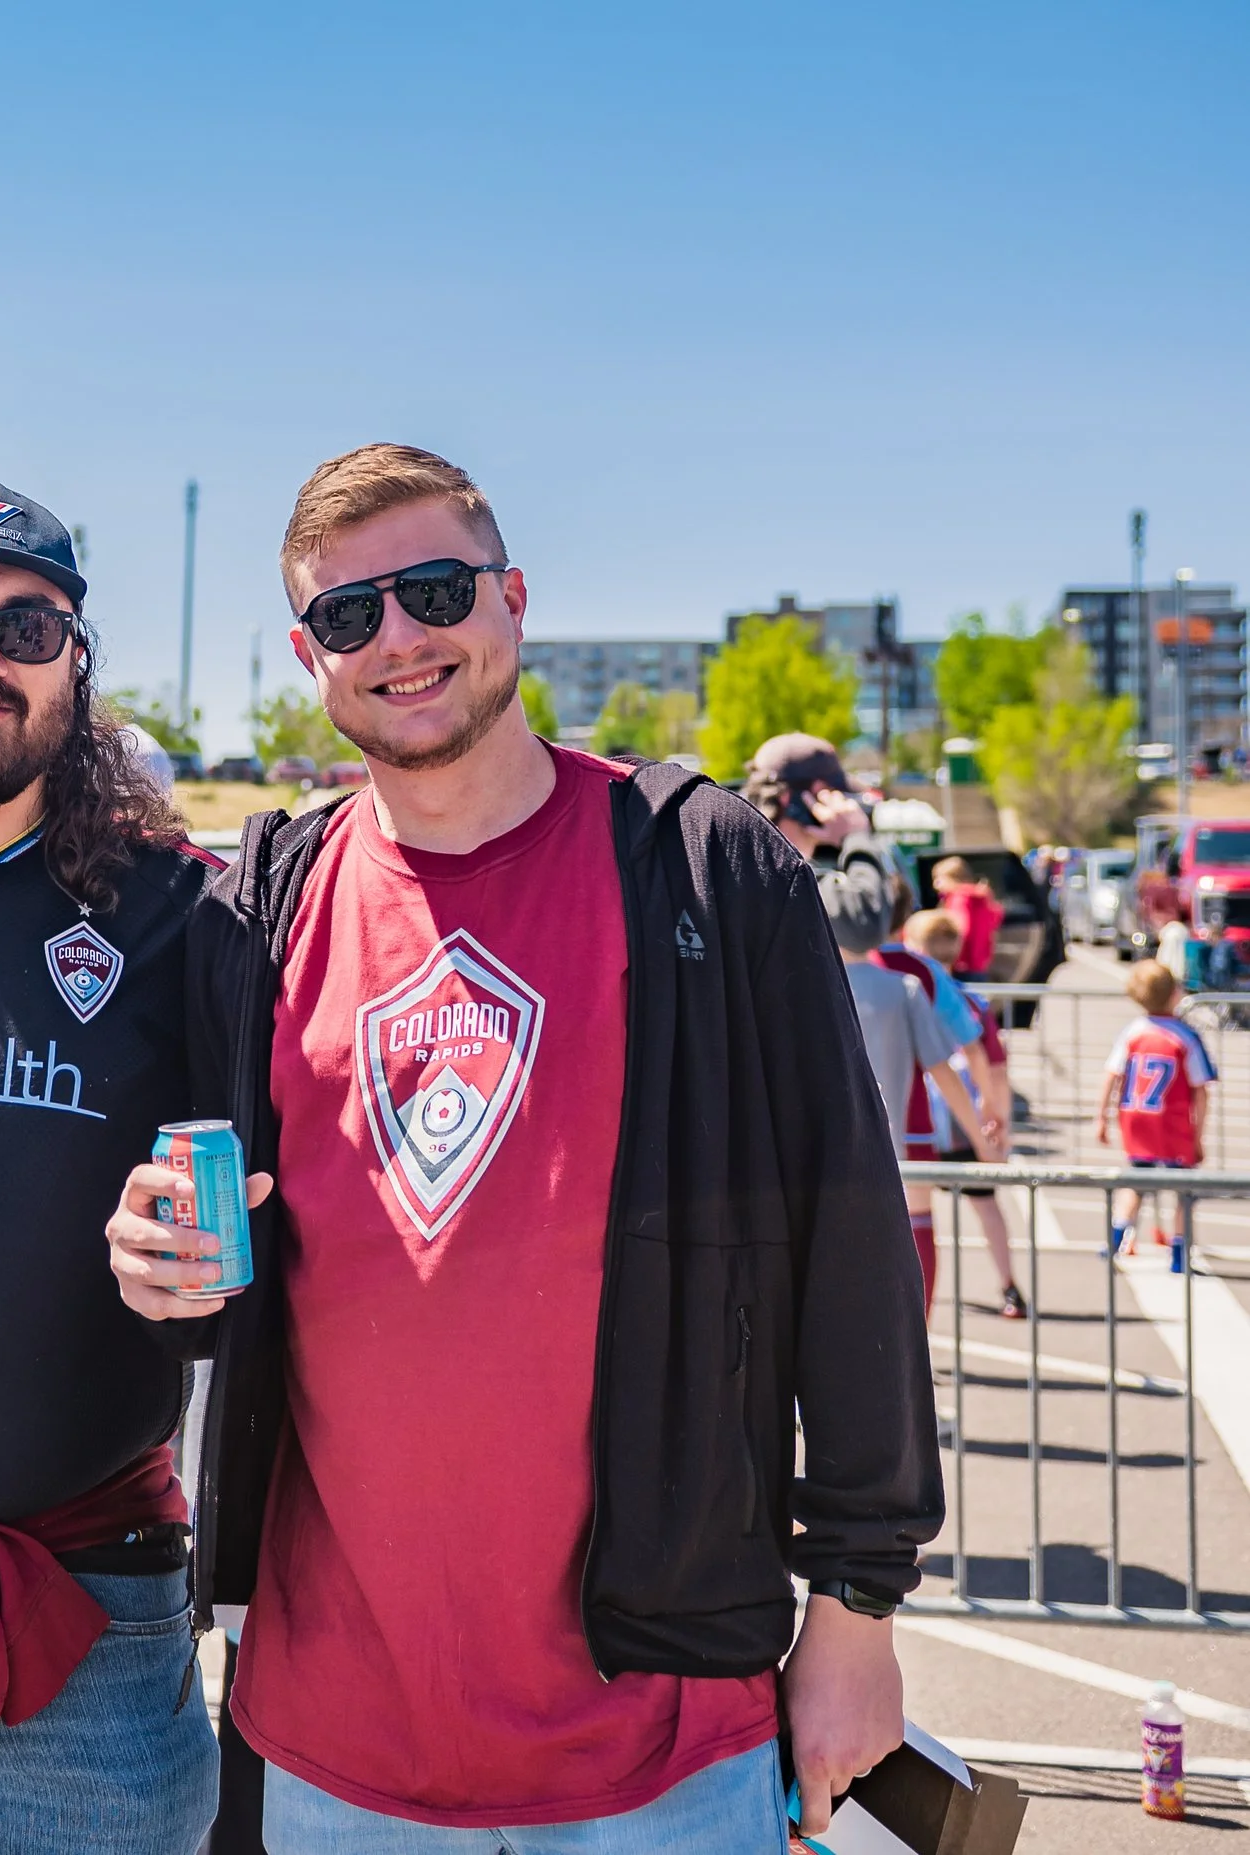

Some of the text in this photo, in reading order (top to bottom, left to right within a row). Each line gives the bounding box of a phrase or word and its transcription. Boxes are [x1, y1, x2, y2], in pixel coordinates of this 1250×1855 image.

[58, 946, 109, 967] COLORADO
[68, 958, 99, 967] RAPIDS
[389, 1001, 510, 1053] COLORADO
[415, 1041, 483, 1062] RAPIDS
[1119, 1054, 1178, 1113] 17
[429, 1143, 447, 1153] 96
